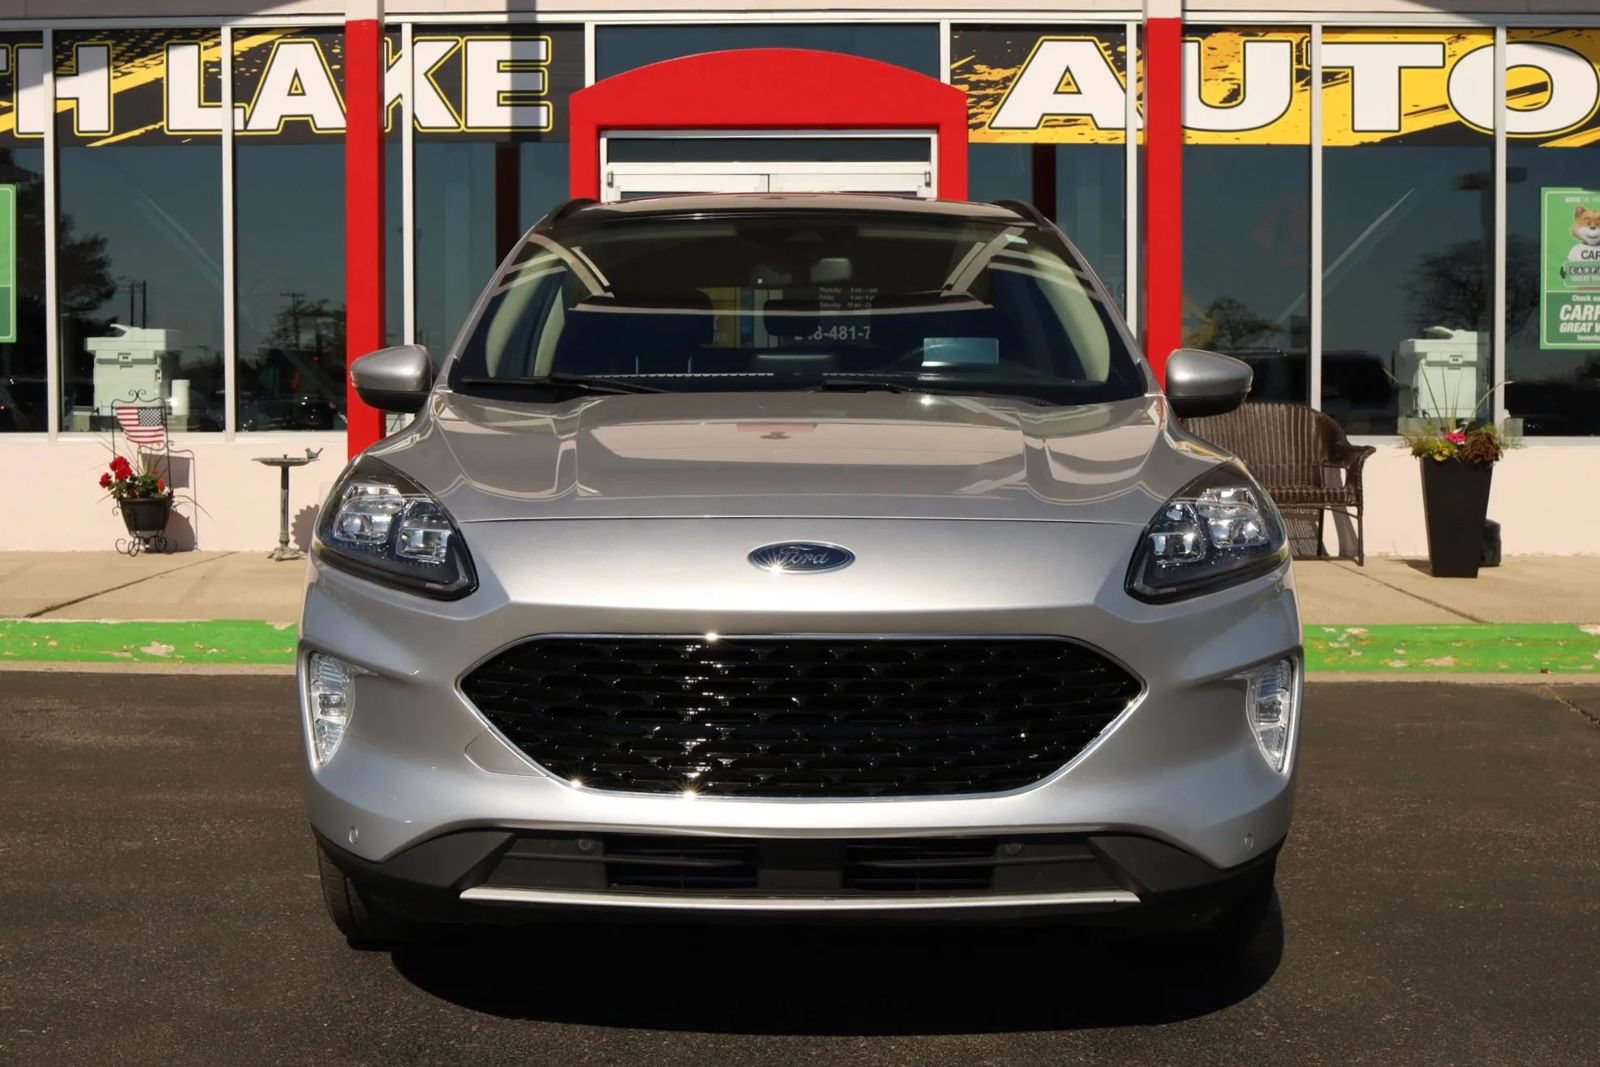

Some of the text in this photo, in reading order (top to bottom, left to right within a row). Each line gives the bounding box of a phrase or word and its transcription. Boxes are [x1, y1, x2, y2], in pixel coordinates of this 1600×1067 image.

[0, 35, 1600, 137] H LAKE AUTO
[1559, 322, 1593, 333] GREAT
[779, 545, 830, 565] Ford
